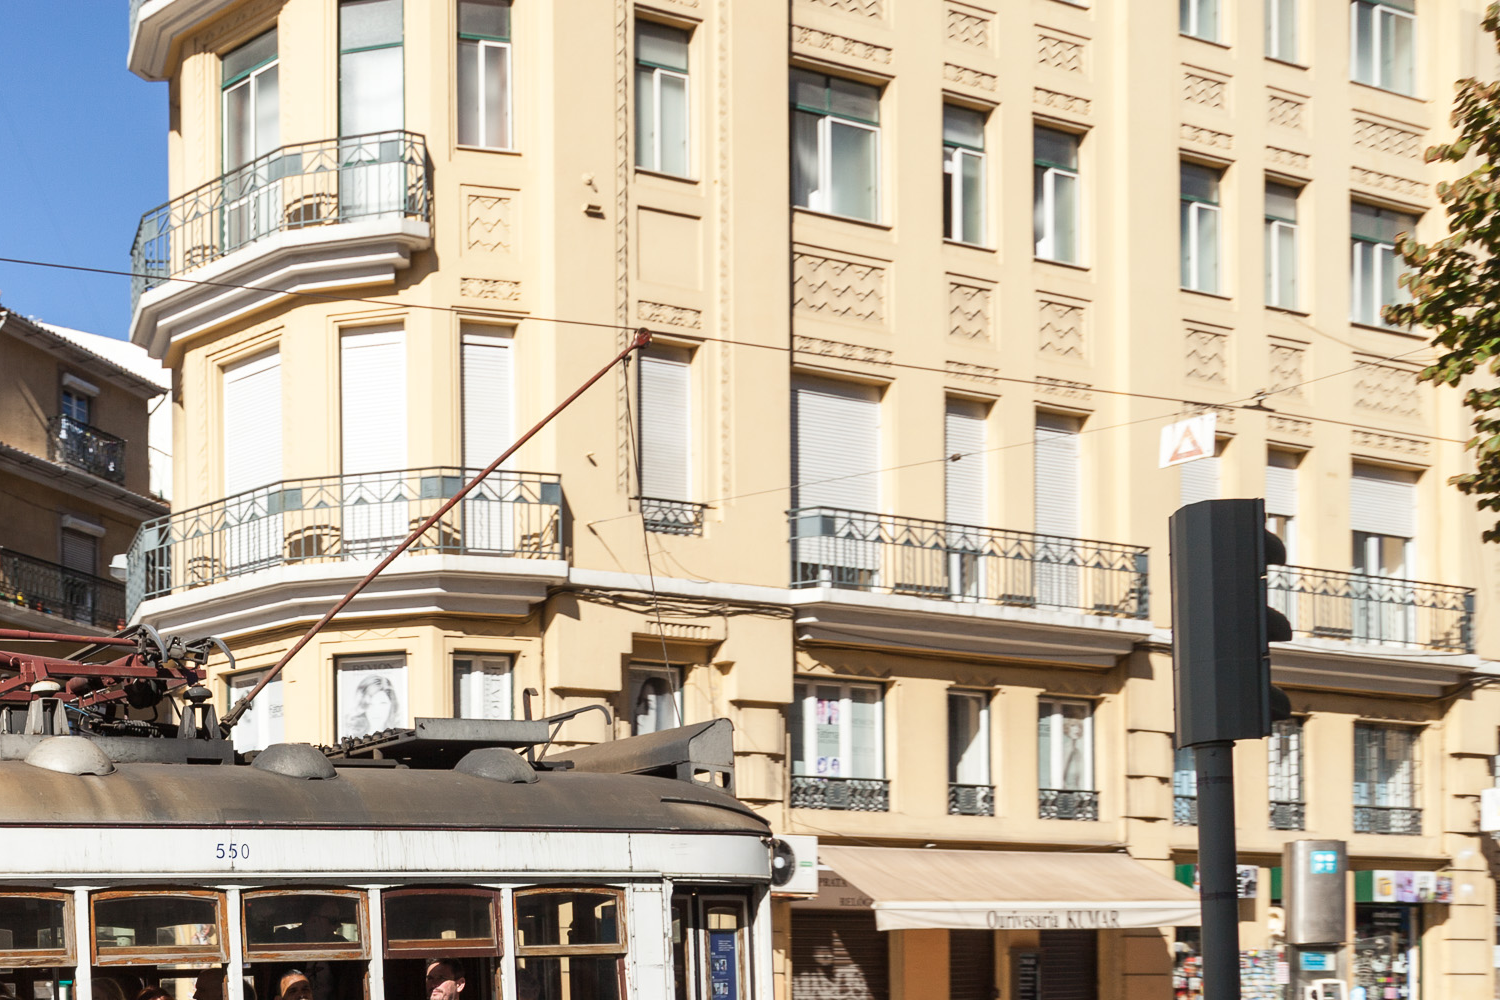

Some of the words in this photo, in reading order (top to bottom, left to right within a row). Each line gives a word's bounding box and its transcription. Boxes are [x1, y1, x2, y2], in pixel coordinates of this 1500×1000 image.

[216, 843, 250, 860] 550
[986, 910, 1059, 929] Ourivesaria
[1066, 910, 1120, 929] KUMAR
